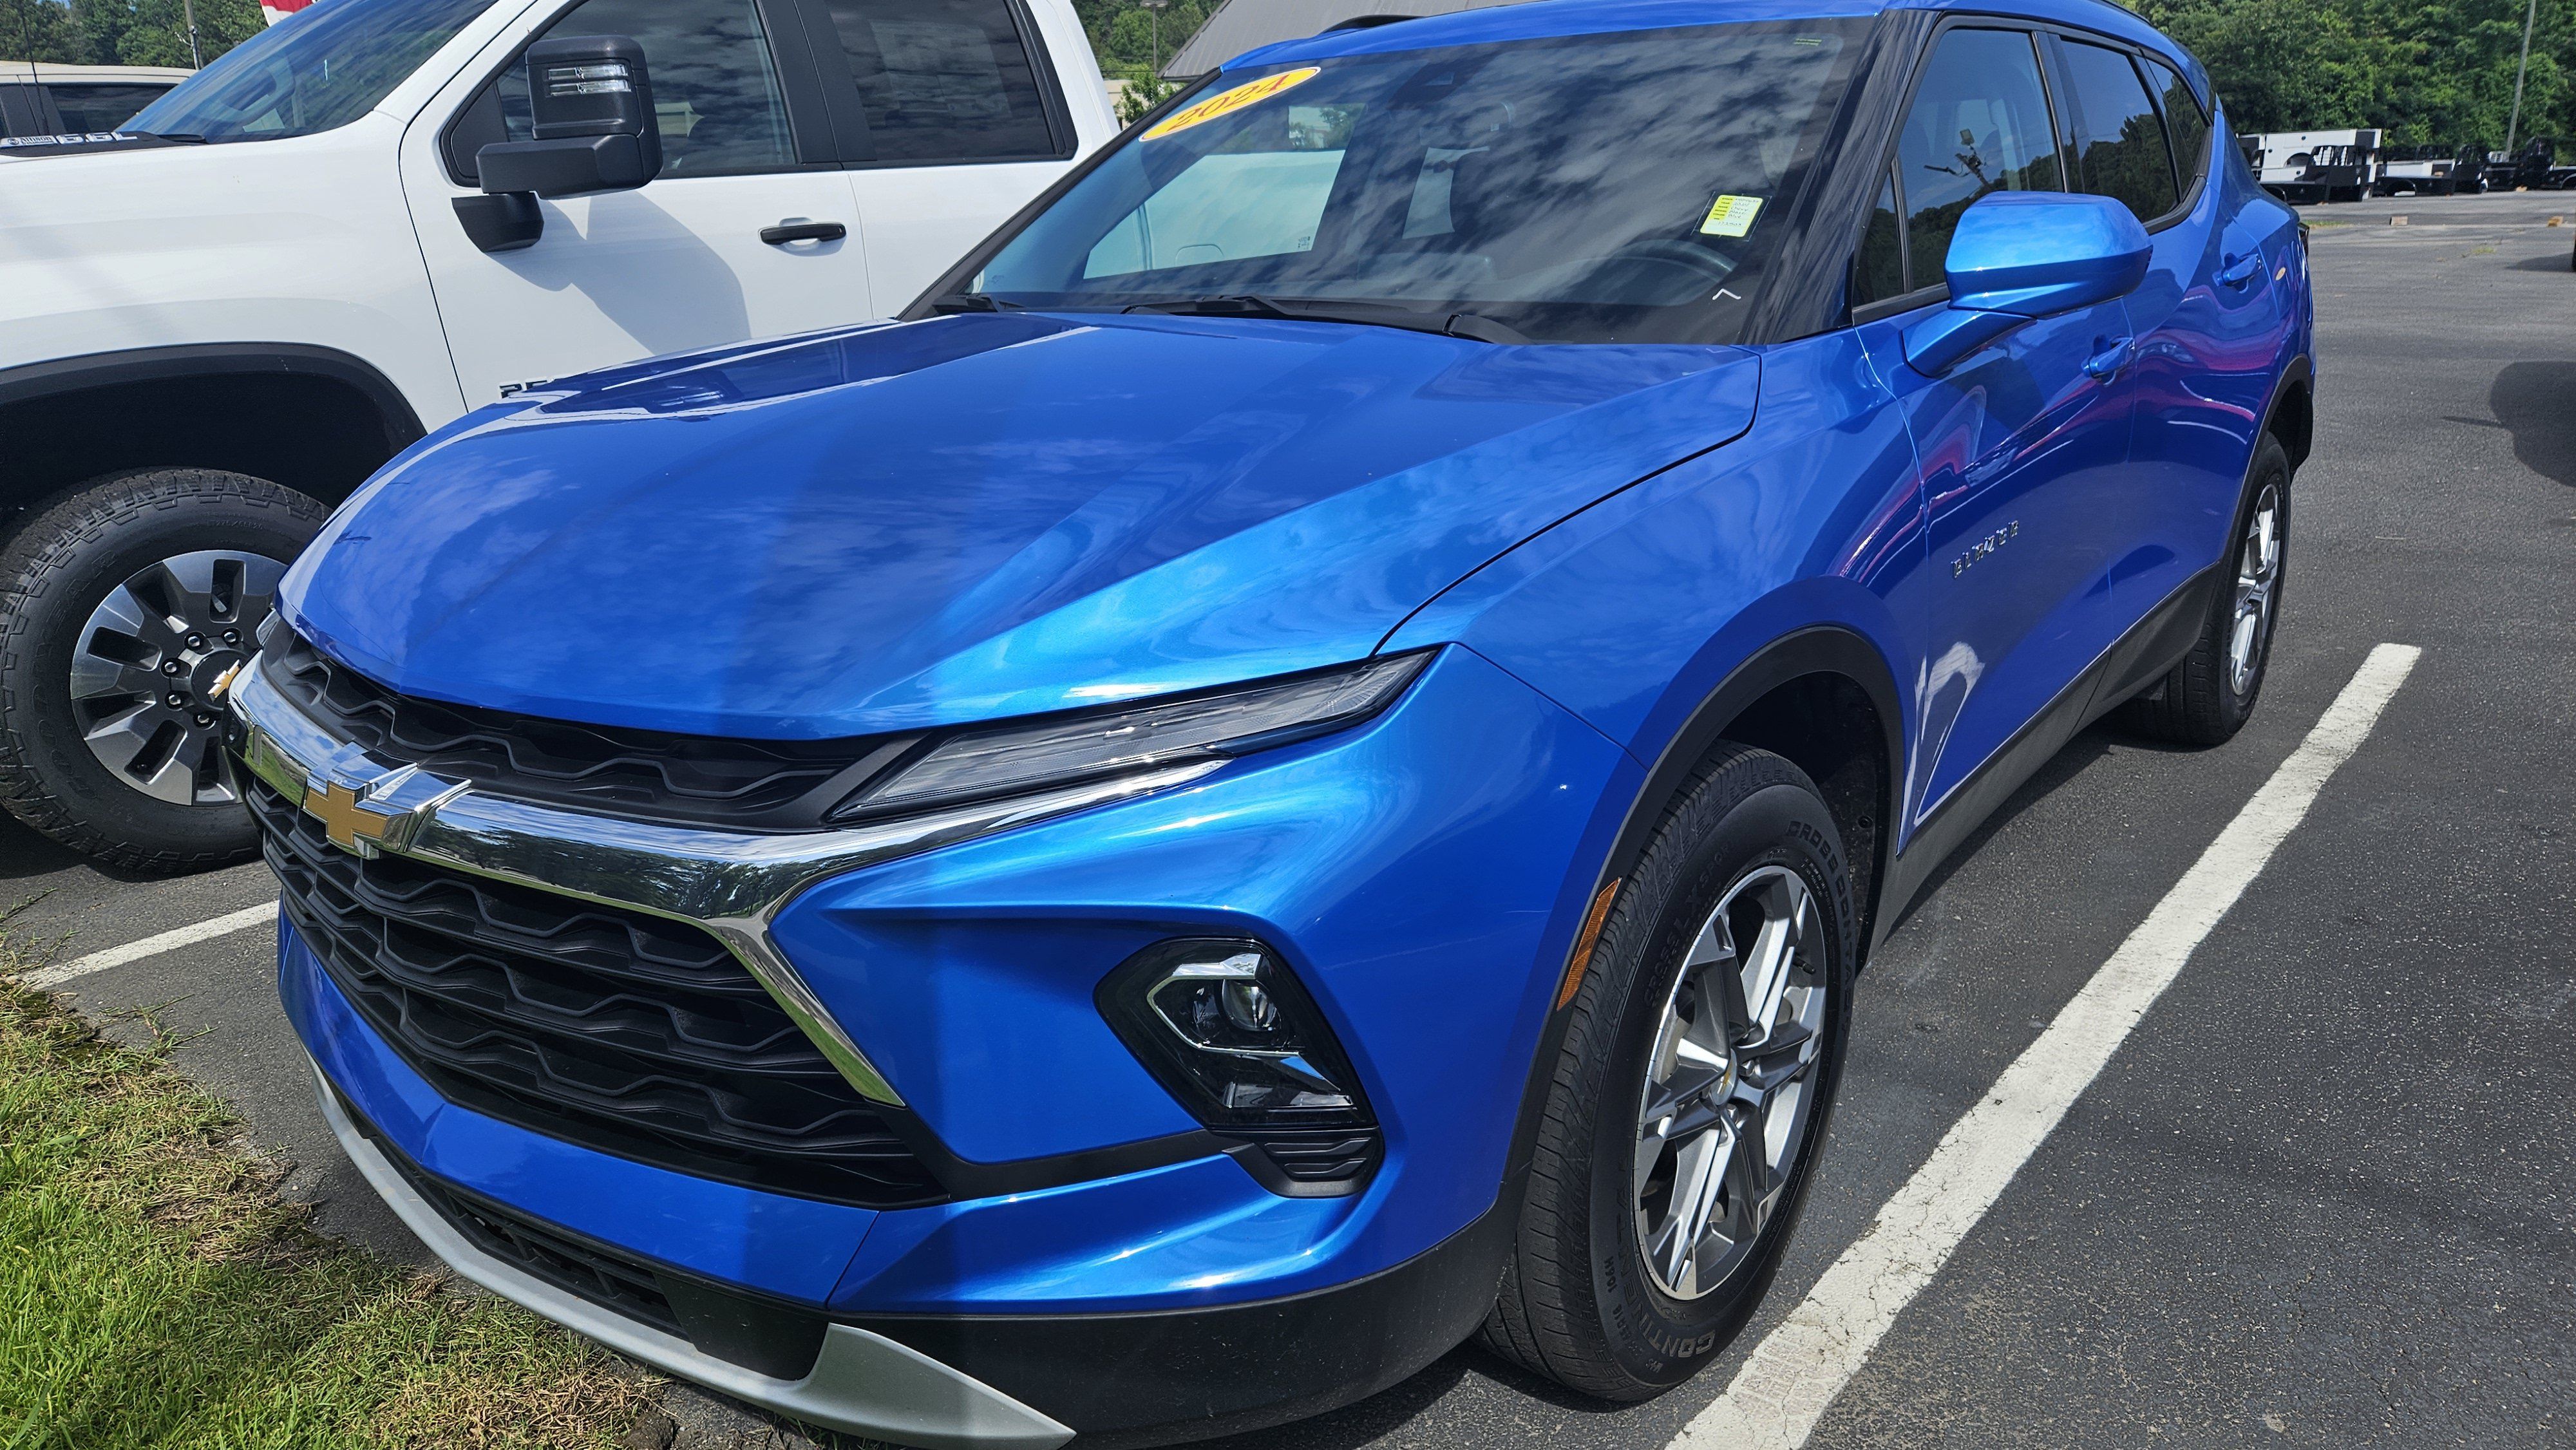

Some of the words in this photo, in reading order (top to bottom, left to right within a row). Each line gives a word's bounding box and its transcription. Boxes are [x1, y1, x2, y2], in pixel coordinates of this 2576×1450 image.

[1166, 73, 1290, 133] 2024
[56, 131, 137, 145] 6.6L
[1951, 520, 2018, 578] BLAZER
